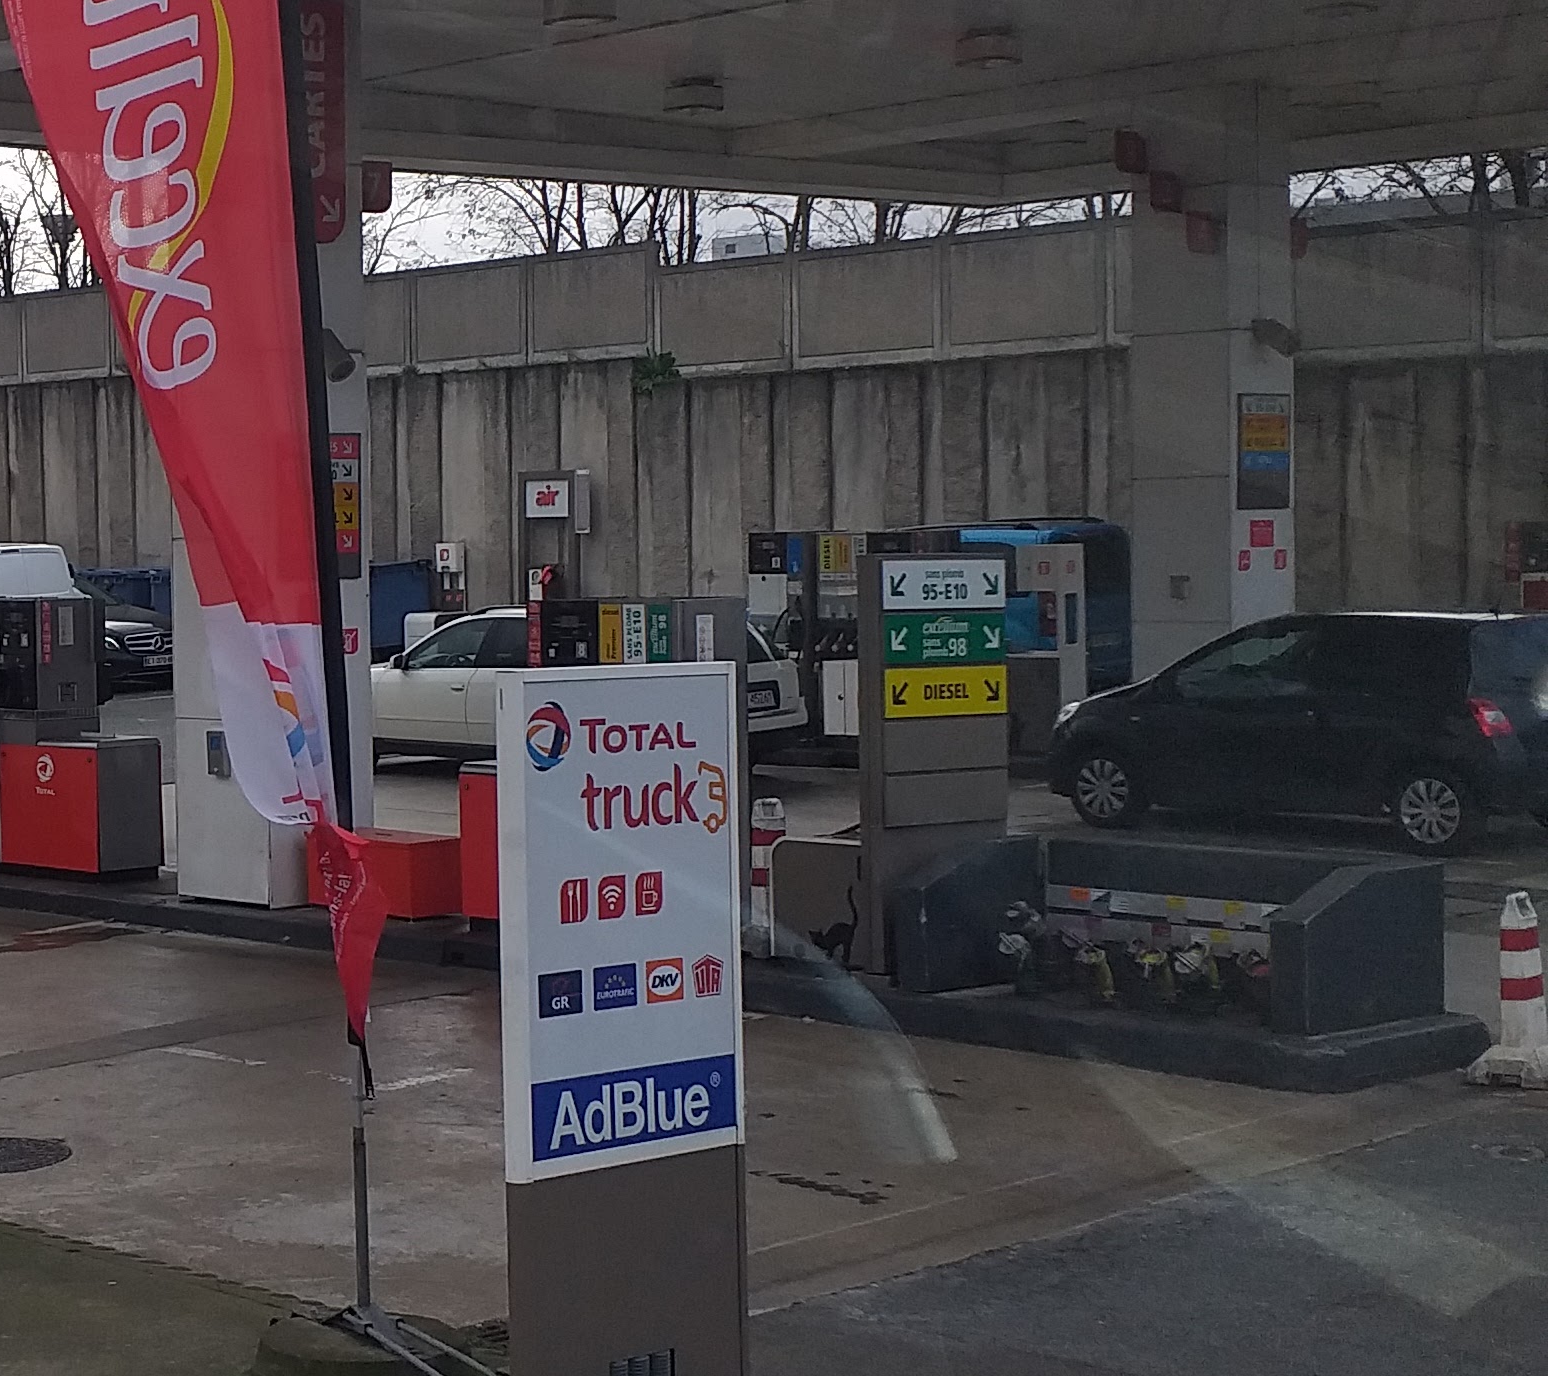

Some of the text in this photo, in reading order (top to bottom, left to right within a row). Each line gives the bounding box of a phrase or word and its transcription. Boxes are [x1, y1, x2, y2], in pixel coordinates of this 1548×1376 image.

[536, 485, 560, 506] air
[922, 583, 968, 600] 95-E10
[633, 610, 643, 657] 95-E10
[948, 637, 967, 657] 98
[923, 683, 969, 700] DIESEL
[579, 718, 697, 754] TOTAL
[580, 763, 700, 831] truck
[651, 973, 680, 989] DKV
[693, 955, 723, 997] UTA
[552, 996, 570, 1010] GR
[596, 987, 635, 1000] EUROTRAFIC
